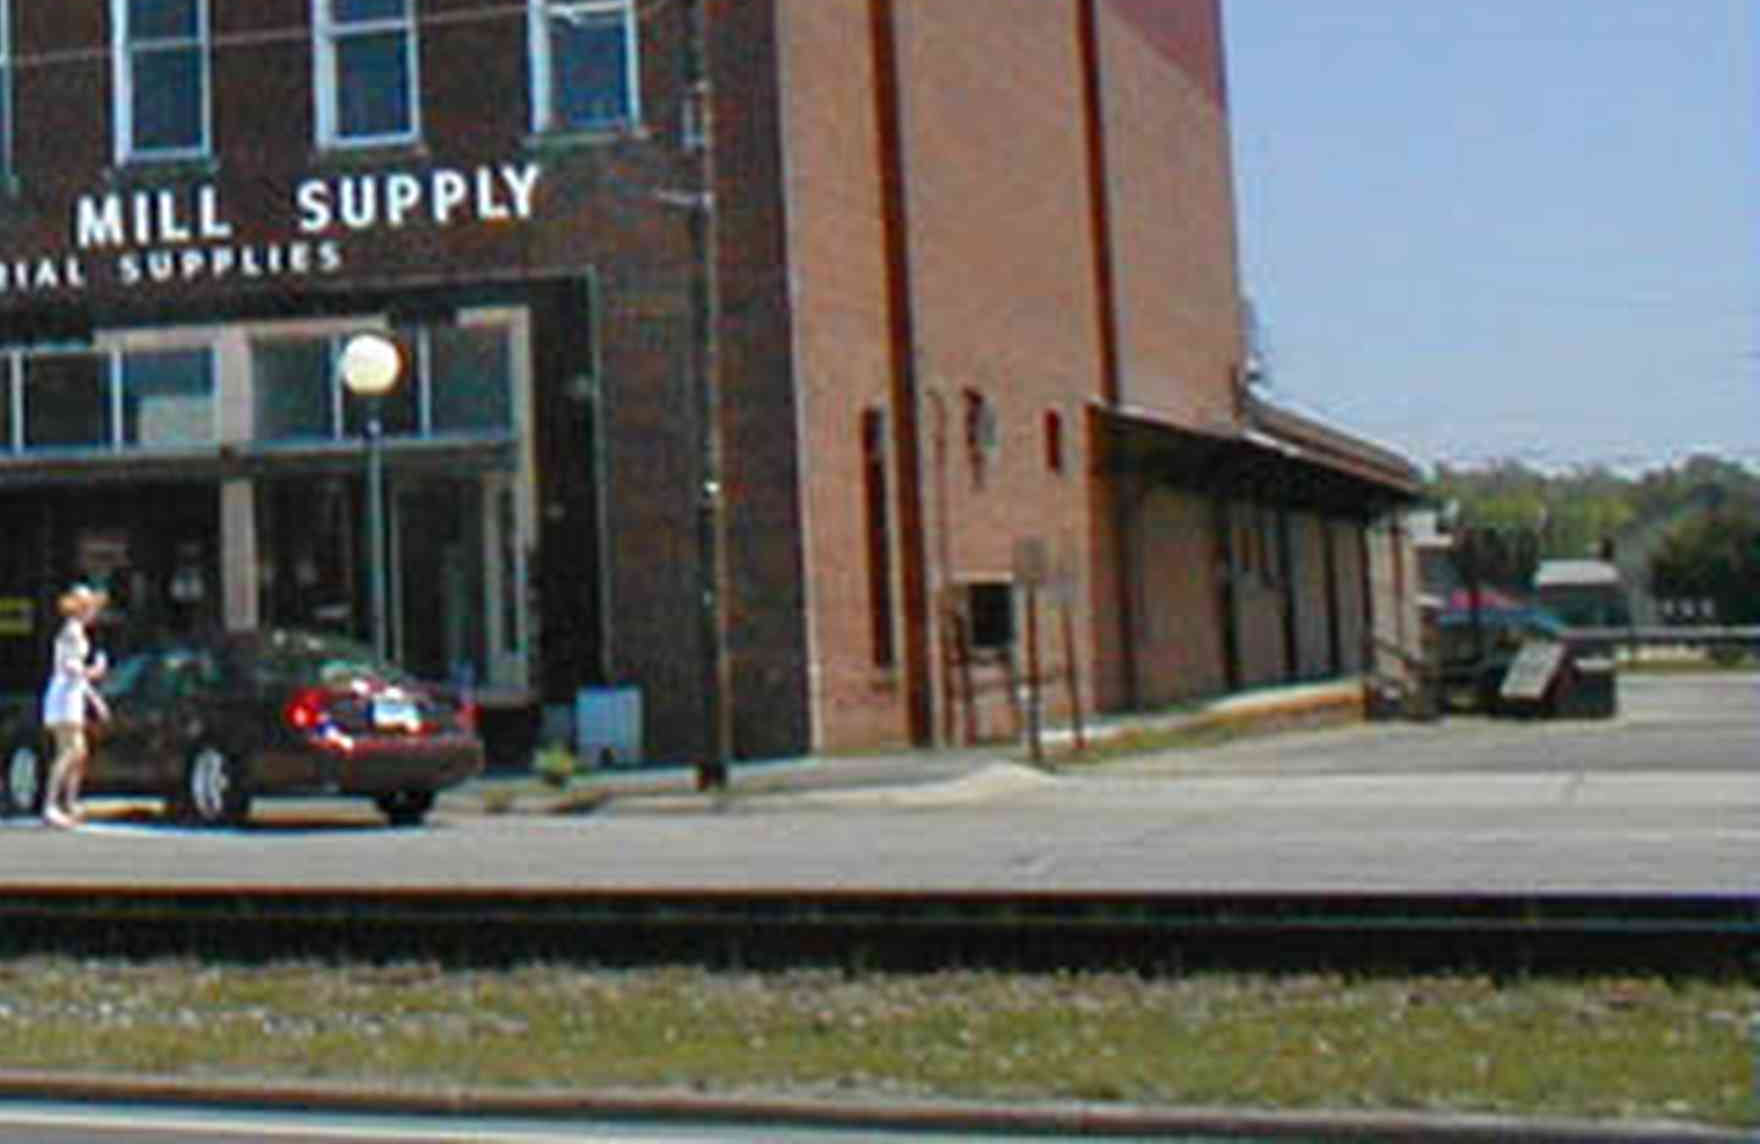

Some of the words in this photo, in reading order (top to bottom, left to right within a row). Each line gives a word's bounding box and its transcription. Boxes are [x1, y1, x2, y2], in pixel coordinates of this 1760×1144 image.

[76, 184, 233, 248] MILL
[296, 162, 540, 232] SUPPLY
[118, 239, 342, 286] SUPPLIES
